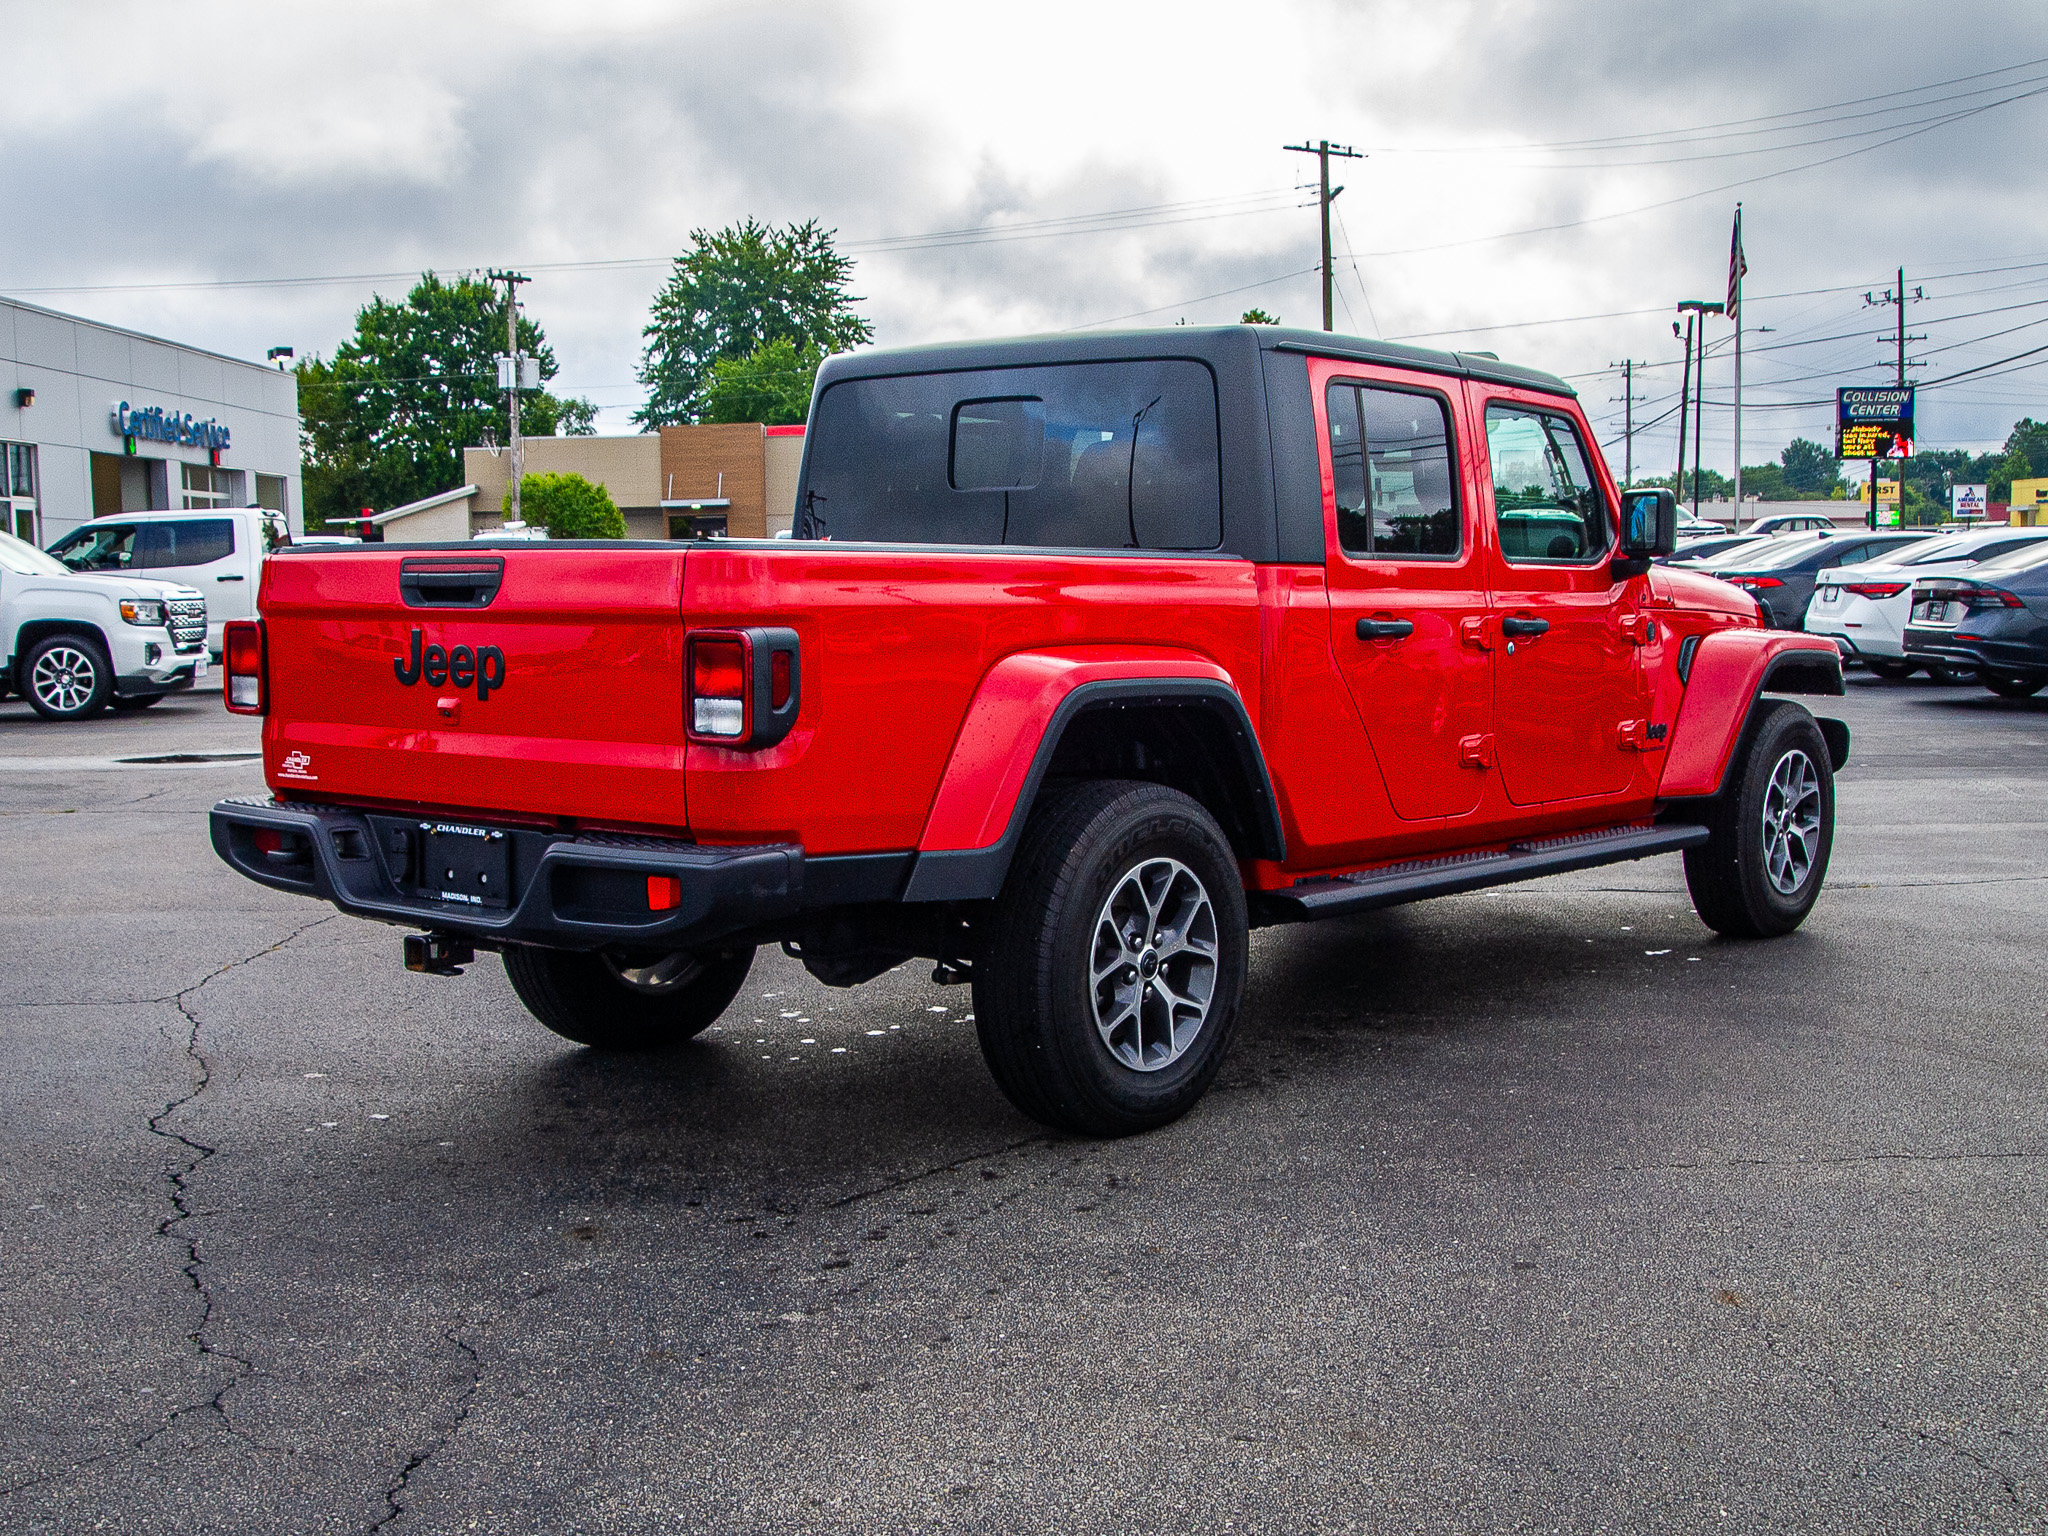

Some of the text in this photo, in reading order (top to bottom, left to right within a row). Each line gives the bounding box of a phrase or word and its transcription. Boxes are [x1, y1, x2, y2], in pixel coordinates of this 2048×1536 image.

[1843, 391, 1910, 402] COLLISION
[1850, 404, 1900, 416] CENTER
[118, 400, 231, 450] Certified Service
[1867, 485, 1895, 494] FRST
[394, 628, 505, 701] Jeep
[436, 824, 486, 837] CHANDLER
